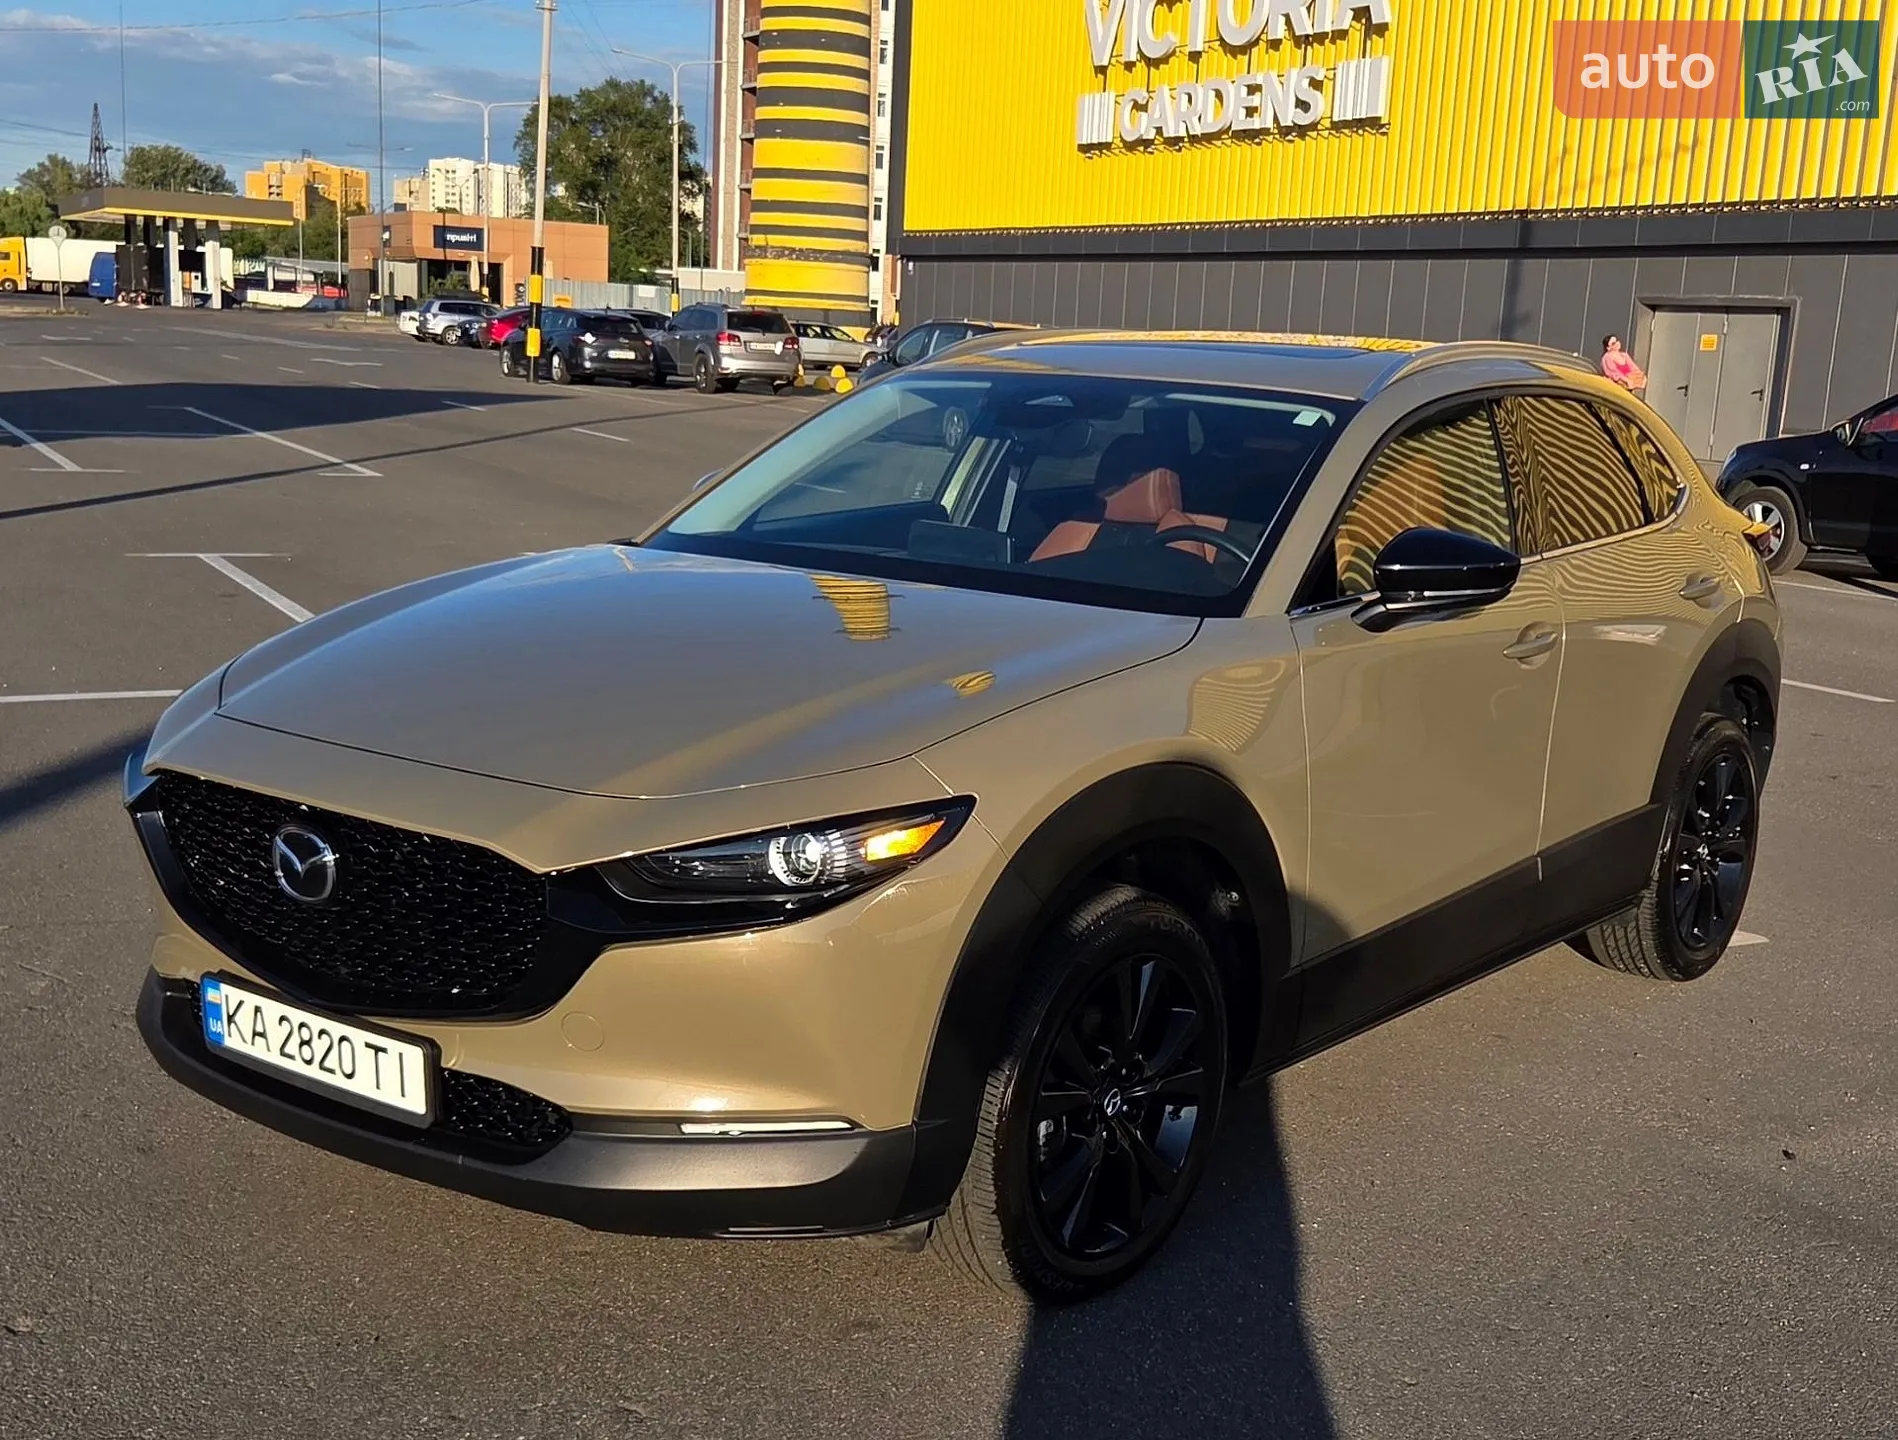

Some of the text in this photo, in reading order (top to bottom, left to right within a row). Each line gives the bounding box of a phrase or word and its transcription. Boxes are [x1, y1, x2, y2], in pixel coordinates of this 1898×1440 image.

[1119, 65, 1327, 142] GARDENS
[209, 1016, 224, 1035] UA
[278, 1015, 356, 1080] 2820
